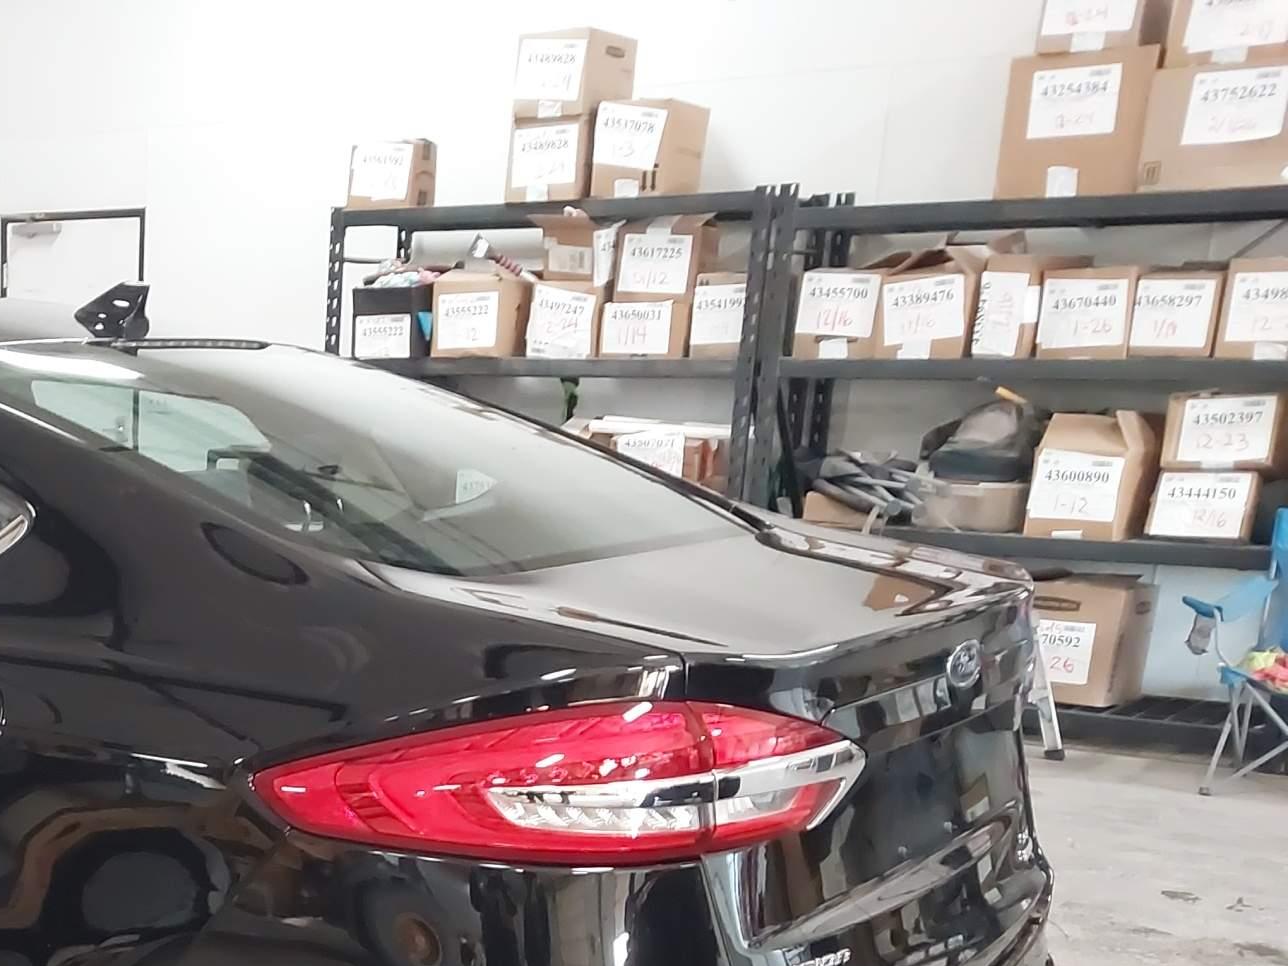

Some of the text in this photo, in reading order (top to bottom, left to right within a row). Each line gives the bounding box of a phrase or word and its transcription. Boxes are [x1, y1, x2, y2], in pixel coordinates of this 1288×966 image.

[1040, 80, 1109, 98] 43254384
[1201, 83, 1279, 104] 43752622
[630, 247, 683, 260] 43617225
[809, 286, 869, 300] 43455700
[892, 288, 955, 309] 43389476
[1051, 295, 1117, 312] 43670440
[1134, 294, 1202, 309] 43658297
[1192, 410, 1264, 426] 43502397
[1044, 468, 1110, 484] 43600890
[1167, 486, 1237, 500] 43444150
[1041, 632, 1081, 649] 70592
